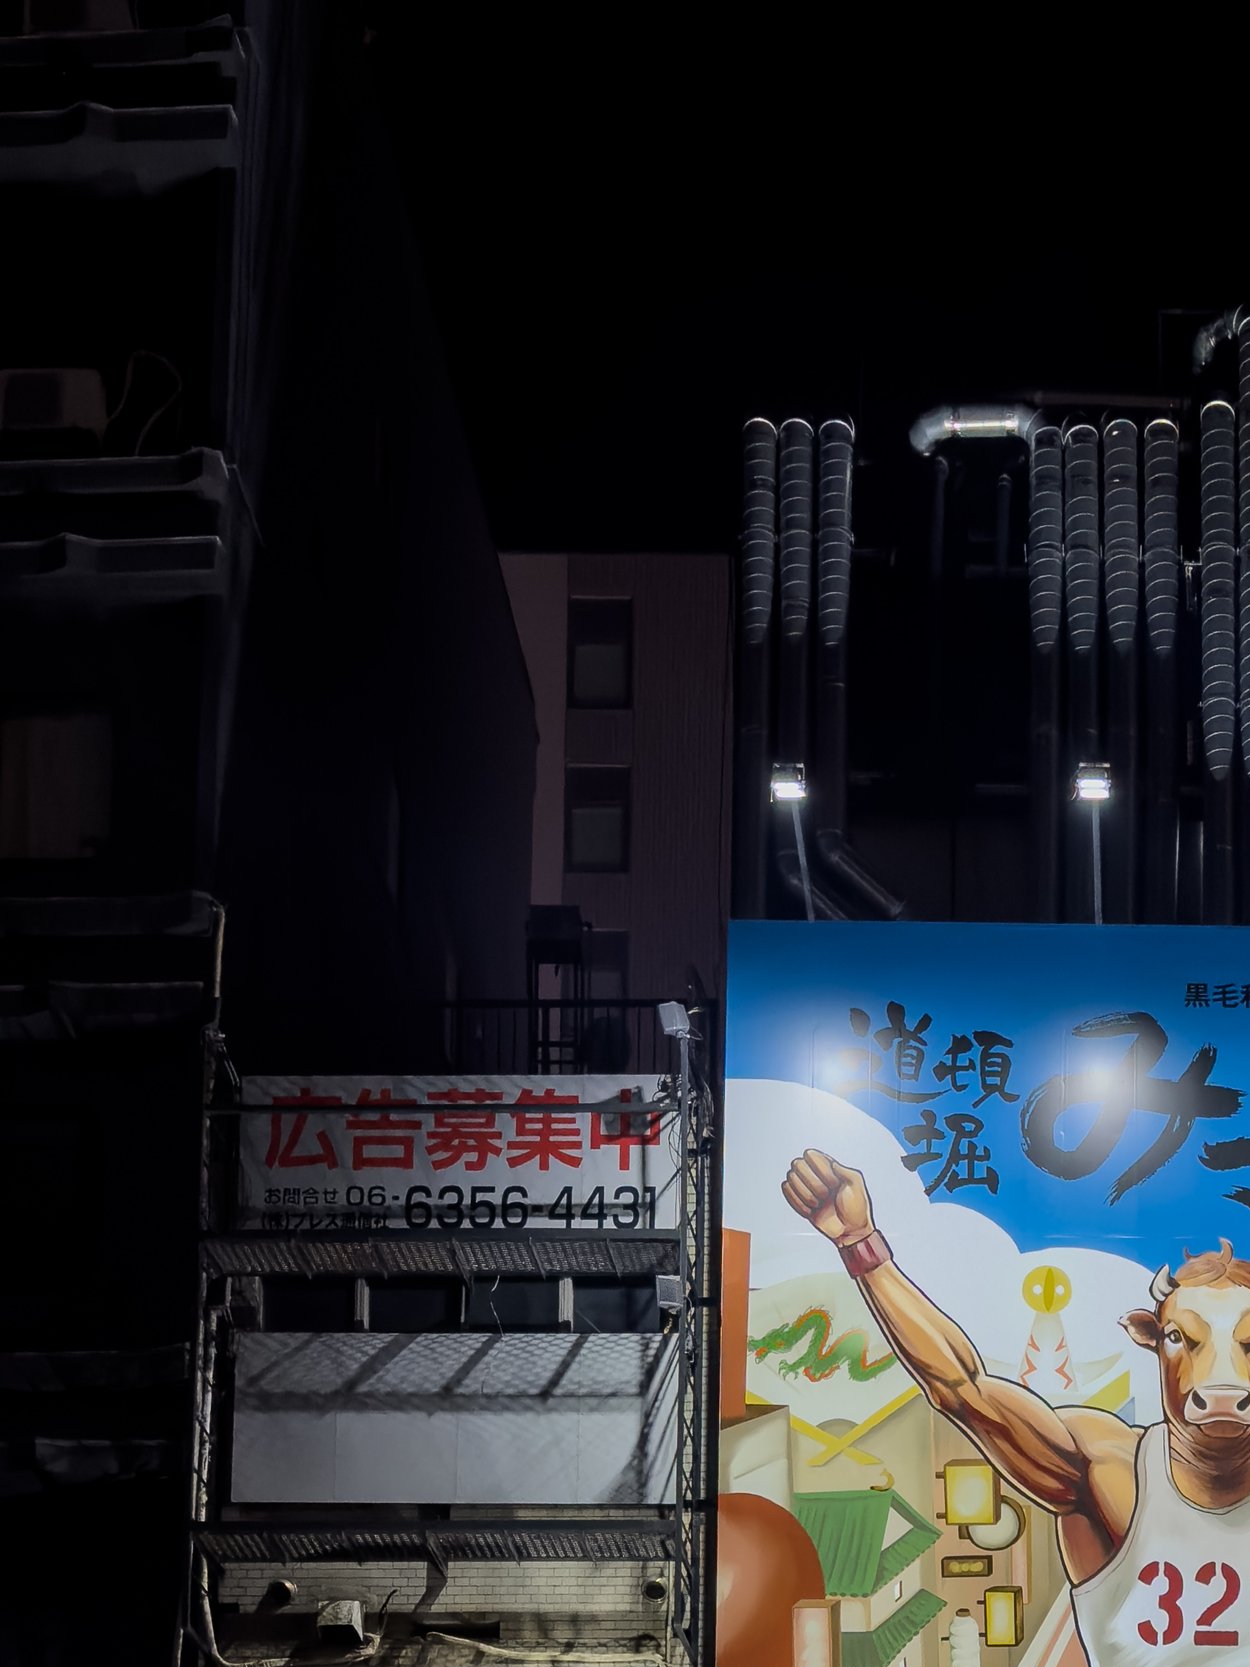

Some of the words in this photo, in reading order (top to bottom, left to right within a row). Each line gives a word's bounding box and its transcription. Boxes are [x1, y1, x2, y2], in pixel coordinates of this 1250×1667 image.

[265, 1088, 661, 1172] 広告募集中
[264, 1186, 339, 1205] お問合せ
